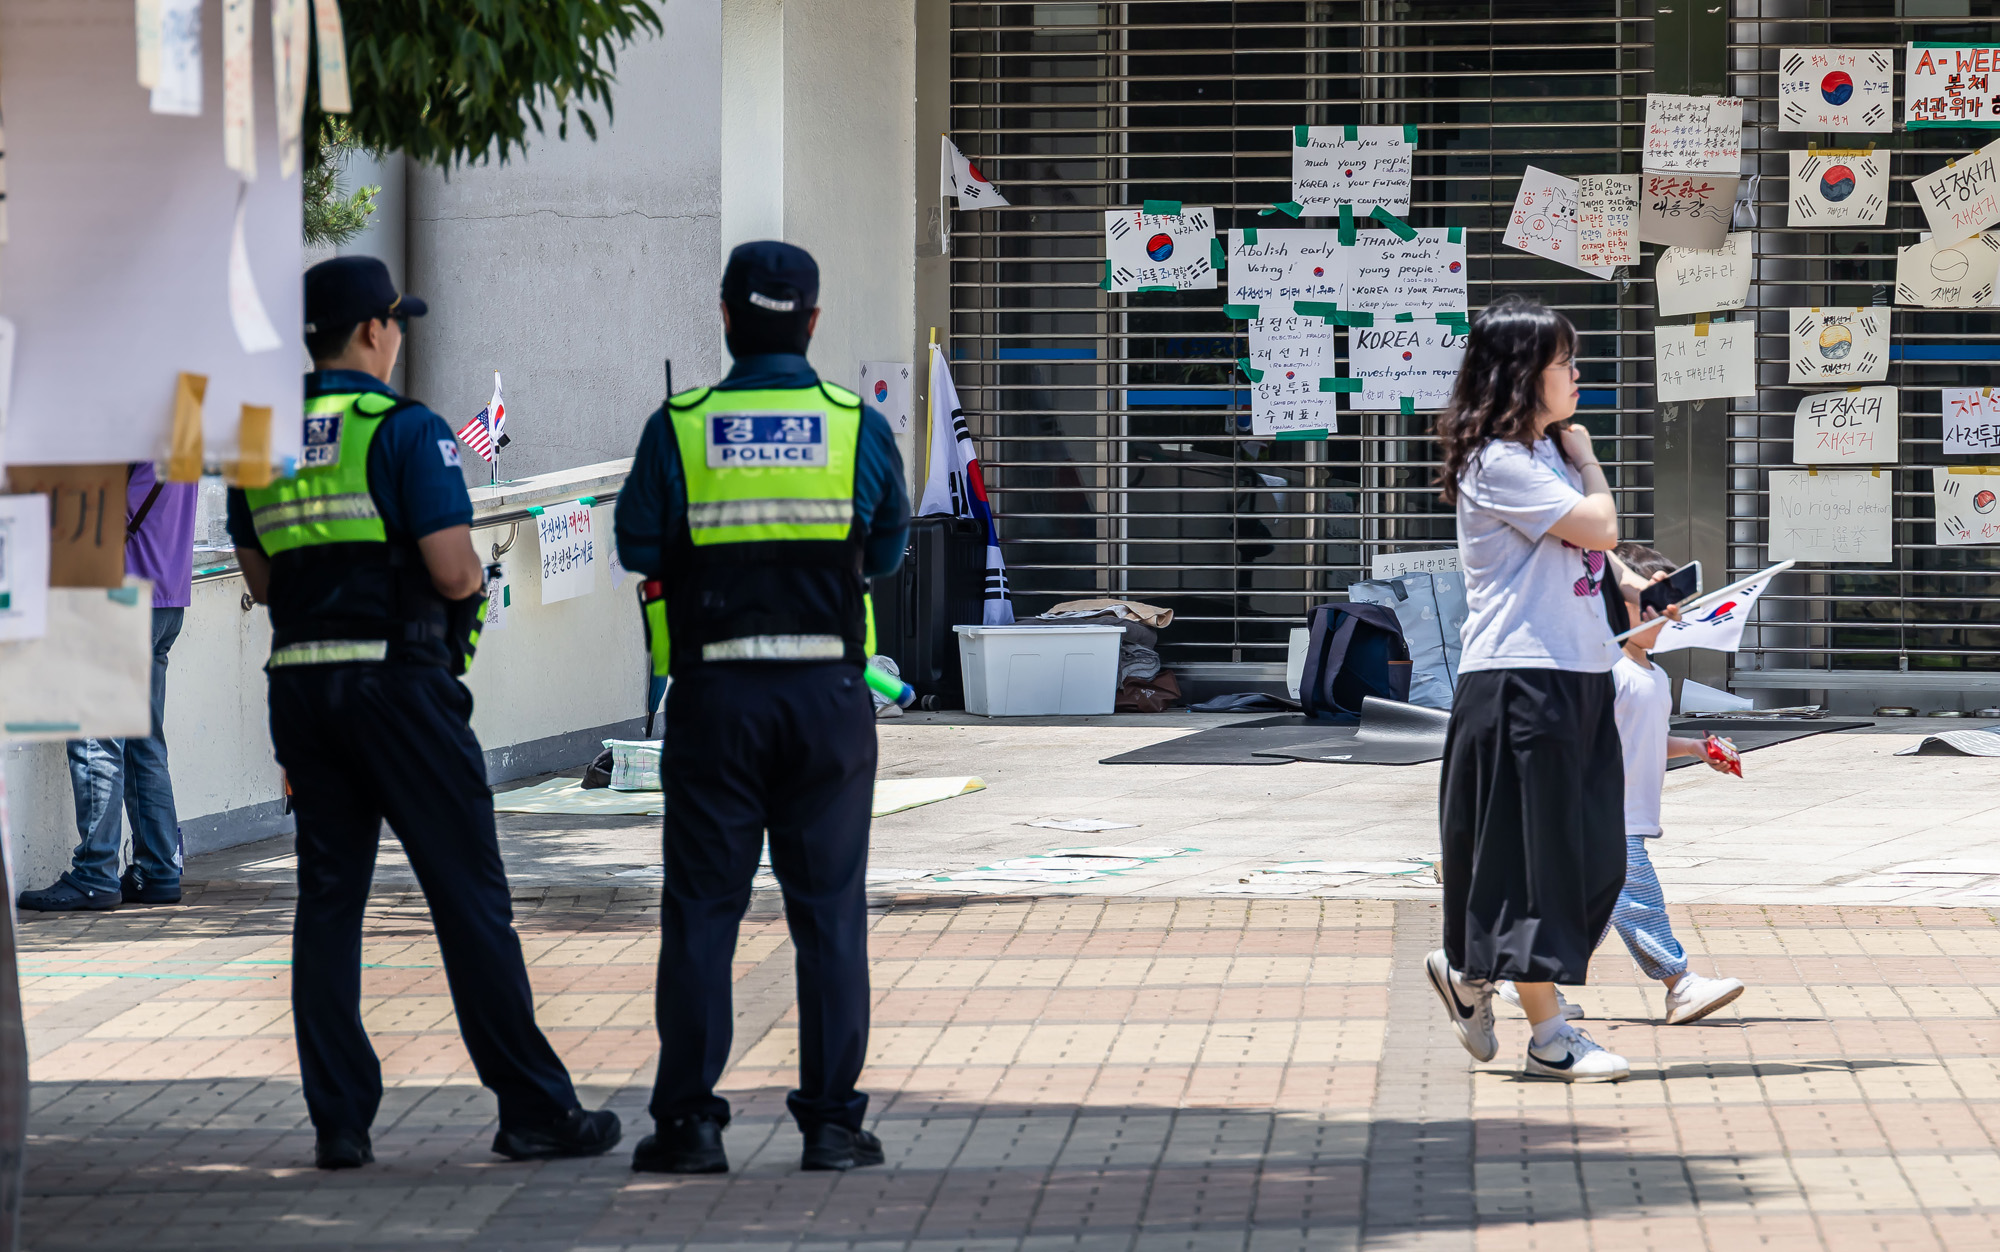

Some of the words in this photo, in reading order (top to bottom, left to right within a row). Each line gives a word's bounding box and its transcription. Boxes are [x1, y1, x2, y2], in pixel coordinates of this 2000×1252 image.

[1863, 80, 1890, 95] 수개표
[1945, 74, 1988, 97] 본체
[1910, 96, 1983, 121] 선관위가
[1307, 136, 1345, 148] Thank
[1358, 139, 1378, 150] you
[1304, 158, 1329, 167] much
[1338, 159, 1367, 170] young
[1348, 180, 1370, 188] your
[1929, 157, 1997, 210] 부정선거
[1333, 197, 1355, 209] your
[1357, 196, 1392, 207] country
[1652, 196, 1705, 219] 대동강
[1827, 206, 1849, 219] 재선거
[1952, 195, 1999, 229] 재선거
[1580, 214, 1603, 228] 내란은
[1607, 214, 1630, 227] 민주당
[1174, 226, 1193, 236] 나라
[1235, 242, 1288, 257] Abolish
[1300, 241, 1335, 259] early
[1362, 237, 1404, 247] THANK
[1417, 237, 1439, 247] you
[1359, 267, 1390, 278] young
[1931, 286, 1962, 303] 재선거
[1382, 301, 1399, 309] your
[1404, 299, 1434, 309] country
[1356, 329, 1420, 350] KOREA
[1356, 365, 1427, 381] investigation
[1661, 370, 1683, 385] 자유
[1686, 364, 1726, 383] 대한민국
[1821, 363, 1851, 374] 재선거
[1809, 397, 1882, 428] 부정선거
[309, 420, 331, 443] 찰
[722, 418, 813, 442] 경찰
[1816, 431, 1874, 456] 재선거
[304, 448, 328, 461] CE
[722, 447, 814, 461] POLICE
[1780, 495, 1801, 519] No
[1809, 500, 1852, 520] rigged
[540, 514, 568, 544] 부정선거
[568, 509, 590, 535] 재선거
[1383, 562, 1407, 576] 자유
[1413, 557, 1457, 573] 대한민국
